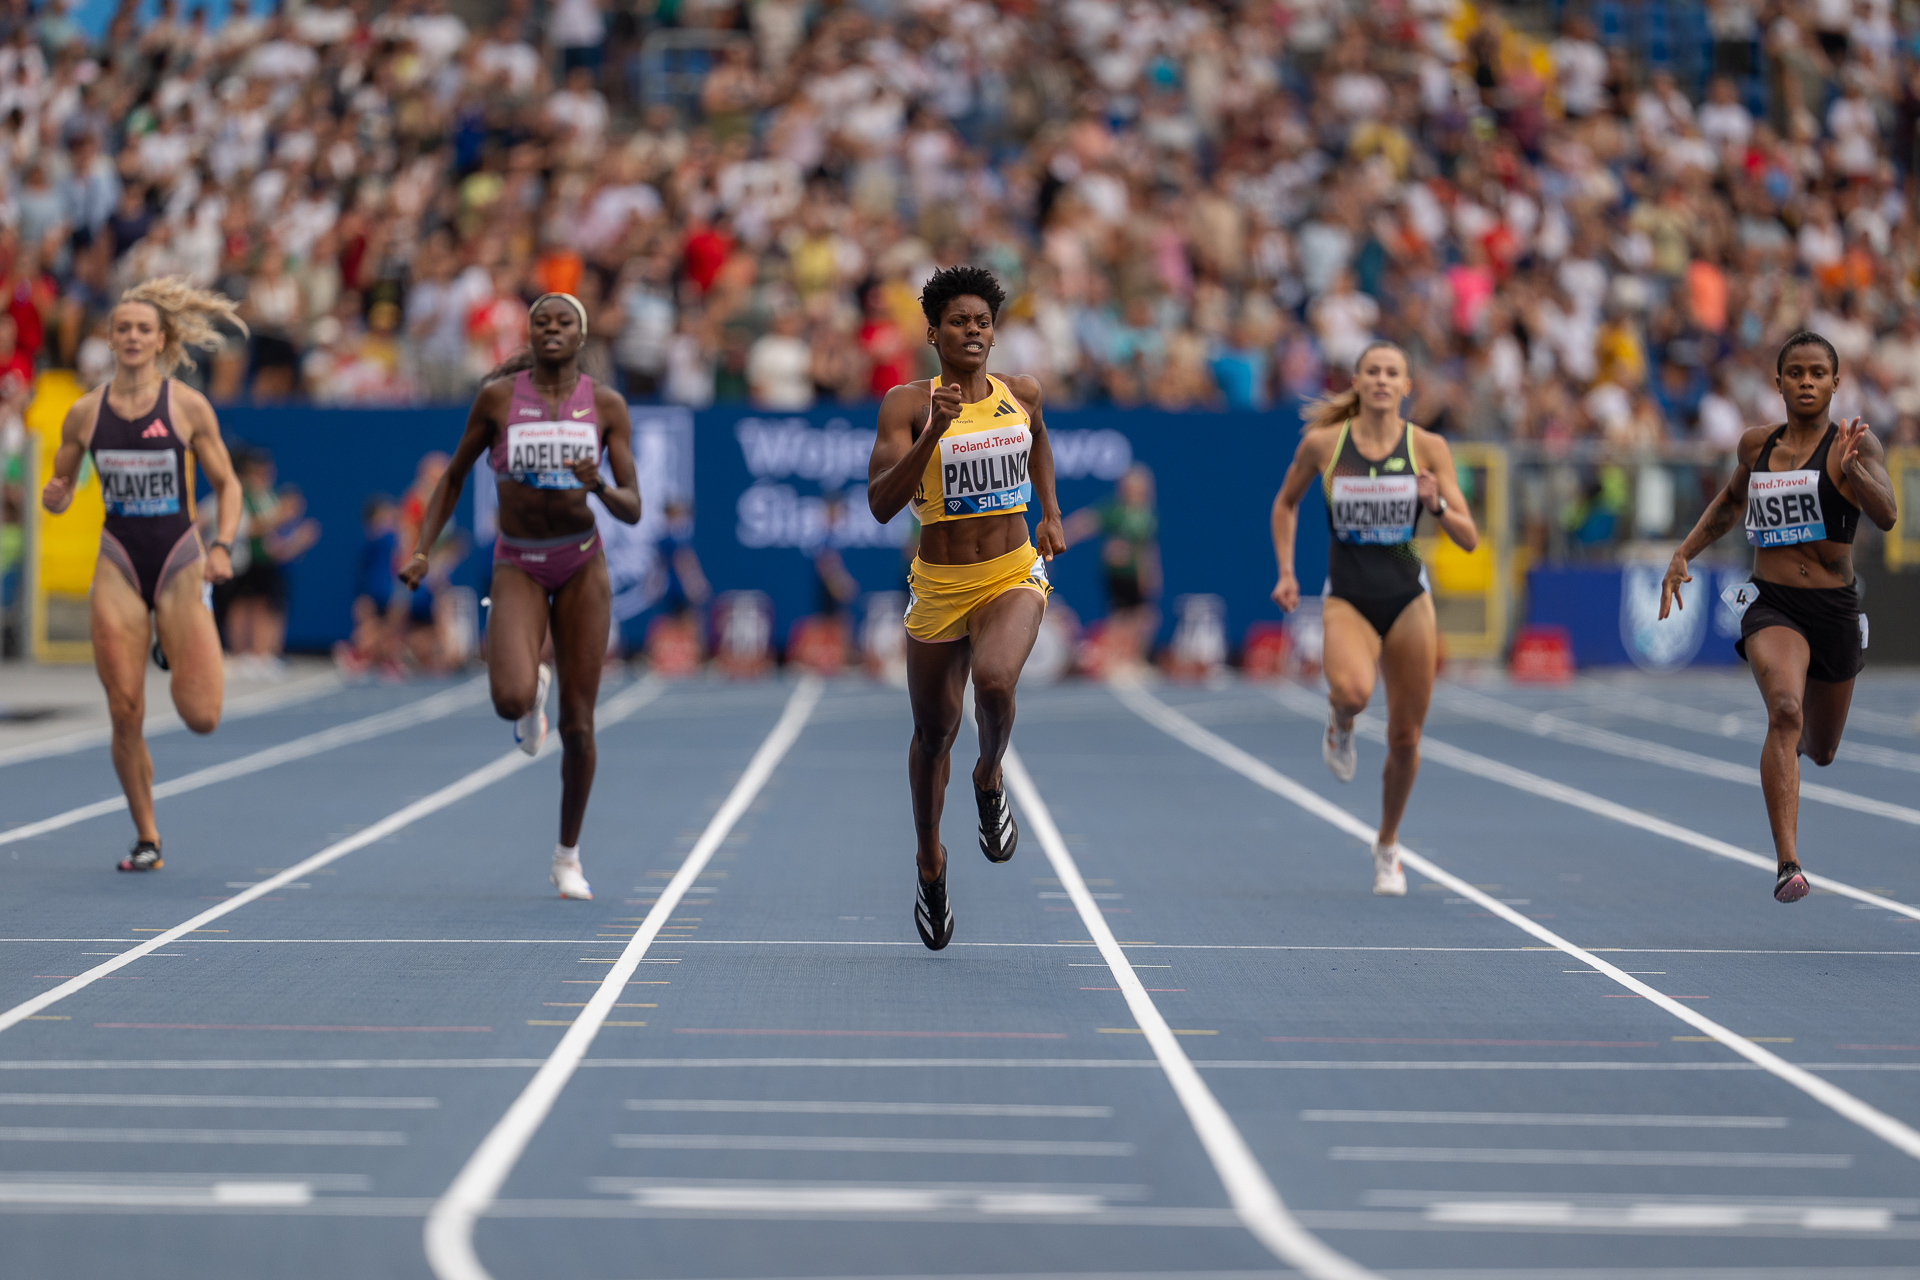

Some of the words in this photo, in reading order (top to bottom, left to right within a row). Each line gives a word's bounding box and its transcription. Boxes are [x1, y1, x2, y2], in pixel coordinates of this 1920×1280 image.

[952, 432, 1025, 454] Poland.Travel
[513, 442, 595, 469] ADELEKE
[944, 450, 1028, 495] PAULINO
[102, 471, 175, 498] KLAVER
[978, 490, 1023, 509] SILESIA
[1763, 527, 1813, 545] SILESIA
[1736, 589, 1747, 605] 4
